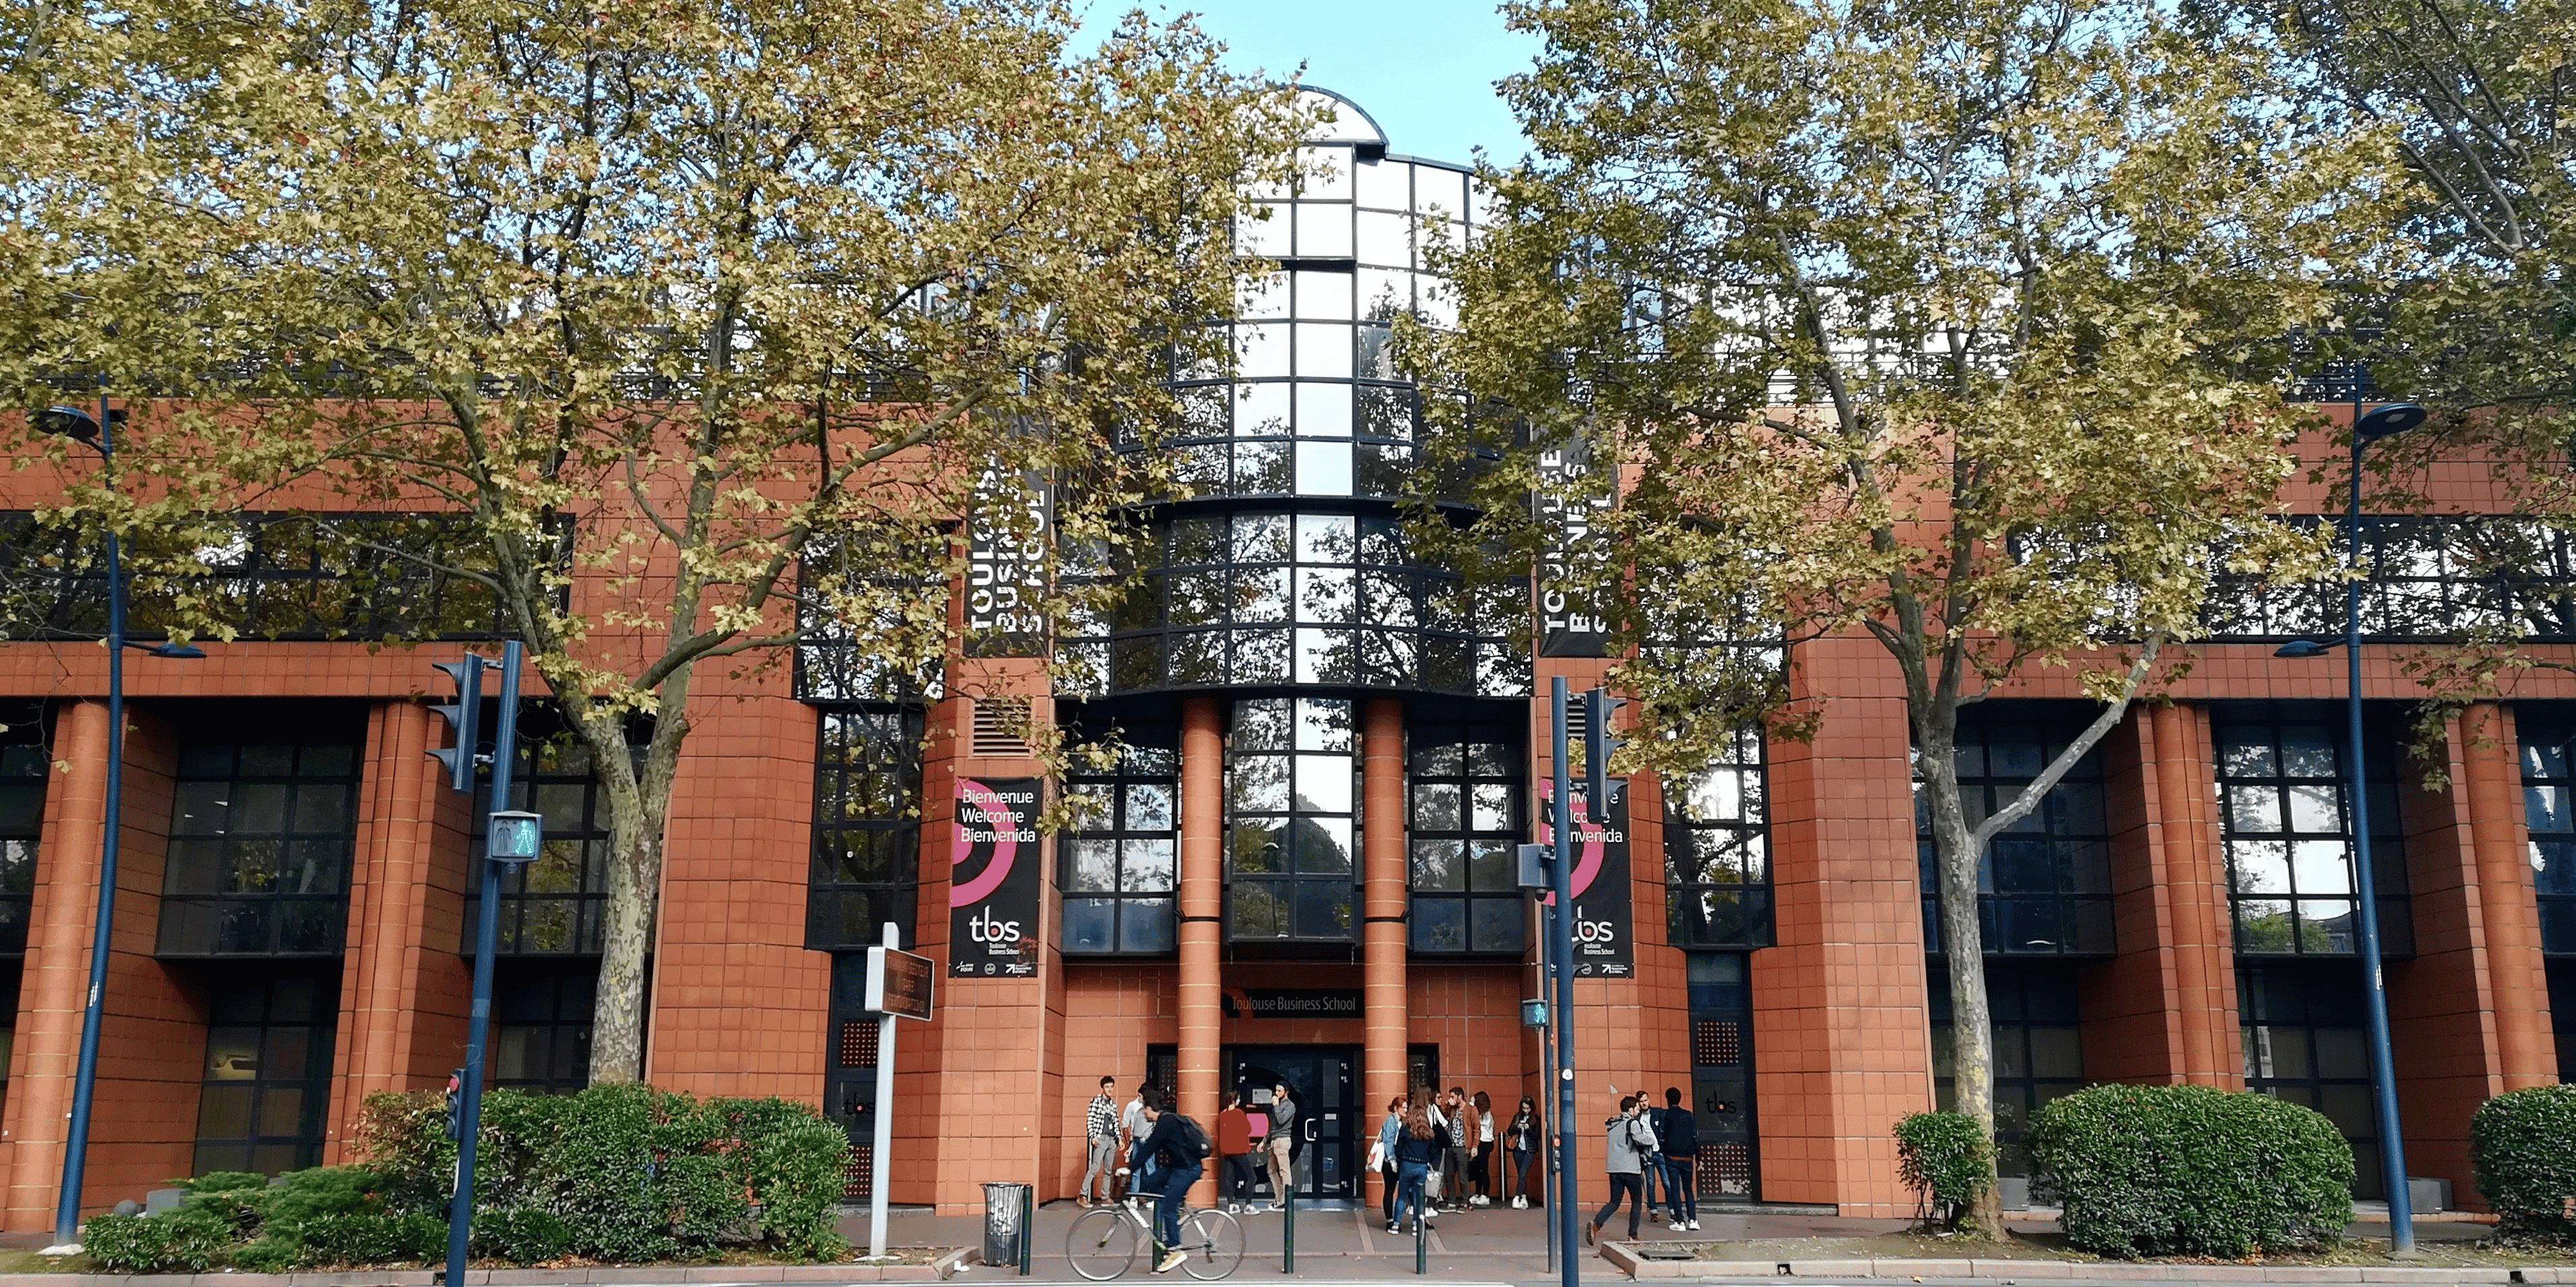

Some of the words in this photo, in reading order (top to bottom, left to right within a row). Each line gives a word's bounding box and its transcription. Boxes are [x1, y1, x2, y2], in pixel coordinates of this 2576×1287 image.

[962, 789, 1034, 804] Bienvenue
[961, 808, 1024, 823] Welcome
[961, 828, 1036, 843] Bienvenida
[1549, 828, 1623, 843] Bnvenida
[969, 905, 1020, 942] tbs
[1571, 905, 1614, 942] bs
[1232, 996, 1275, 1011] Toulouse
[1278, 996, 1321, 1011] Business
[1322, 996, 1356, 1011] School
[845, 1092, 876, 1115] tbs
[1705, 1091, 1738, 1114] tbs
